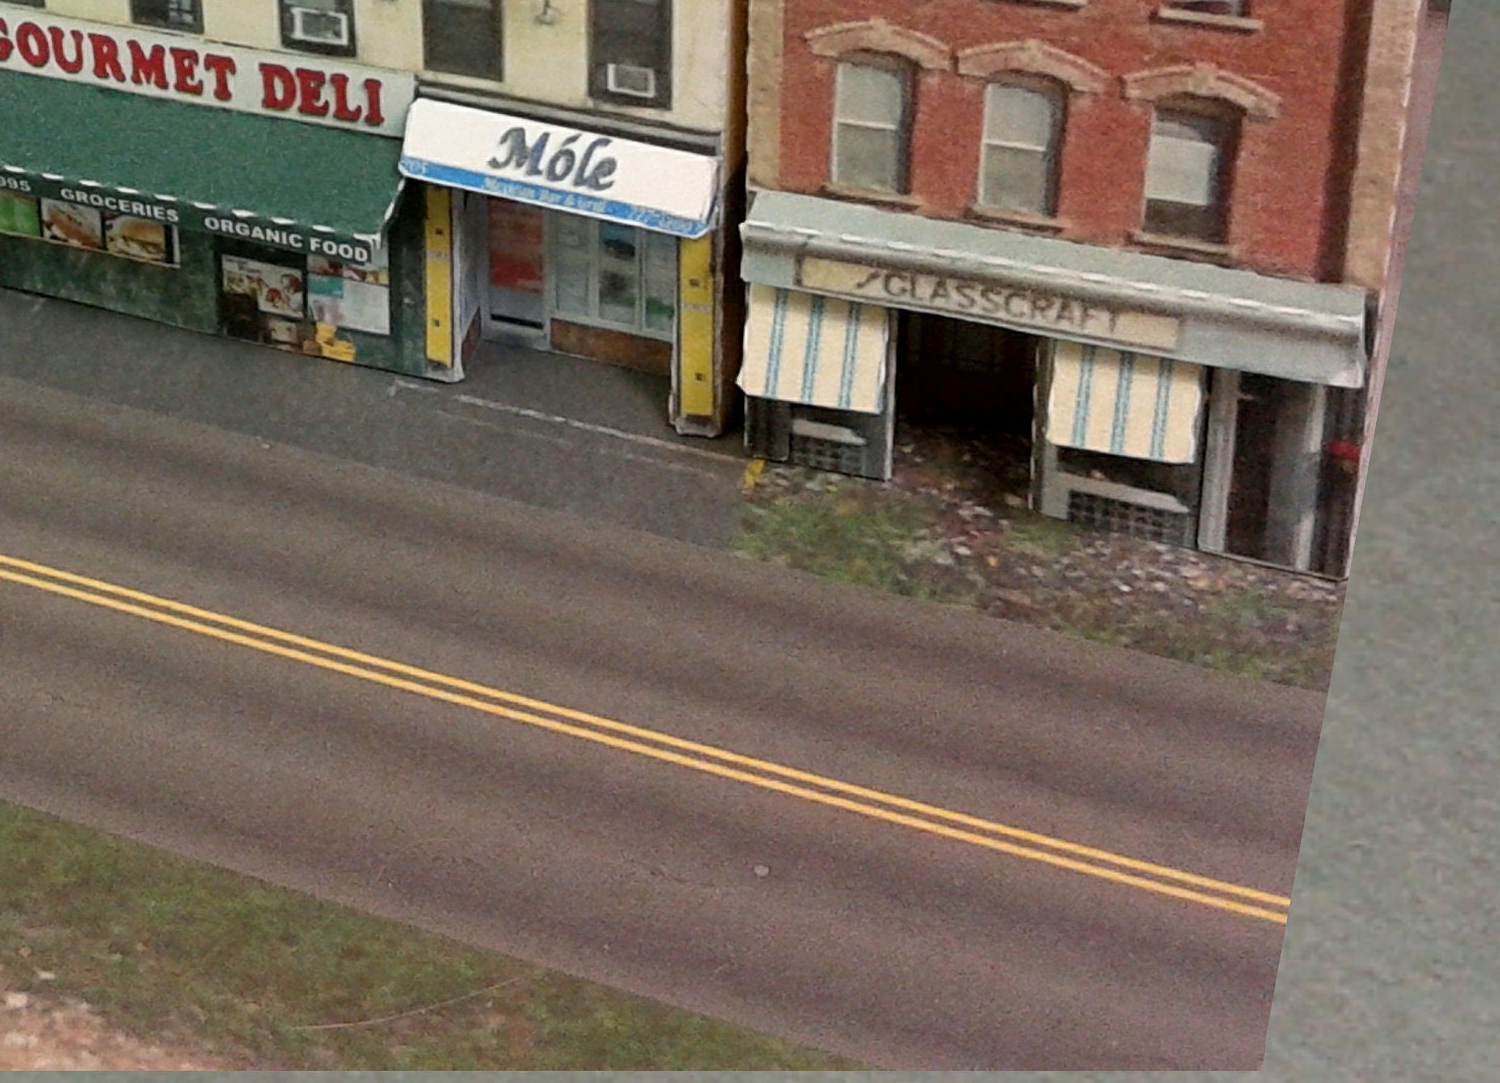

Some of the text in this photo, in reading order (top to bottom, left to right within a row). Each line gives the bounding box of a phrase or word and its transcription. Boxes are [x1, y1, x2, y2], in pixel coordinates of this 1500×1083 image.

[258, 62, 385, 127] DELI
[60, 187, 180, 224] GROCERIES
[204, 215, 304, 249] ORGANIC
[308, 236, 370, 263] FOOD
